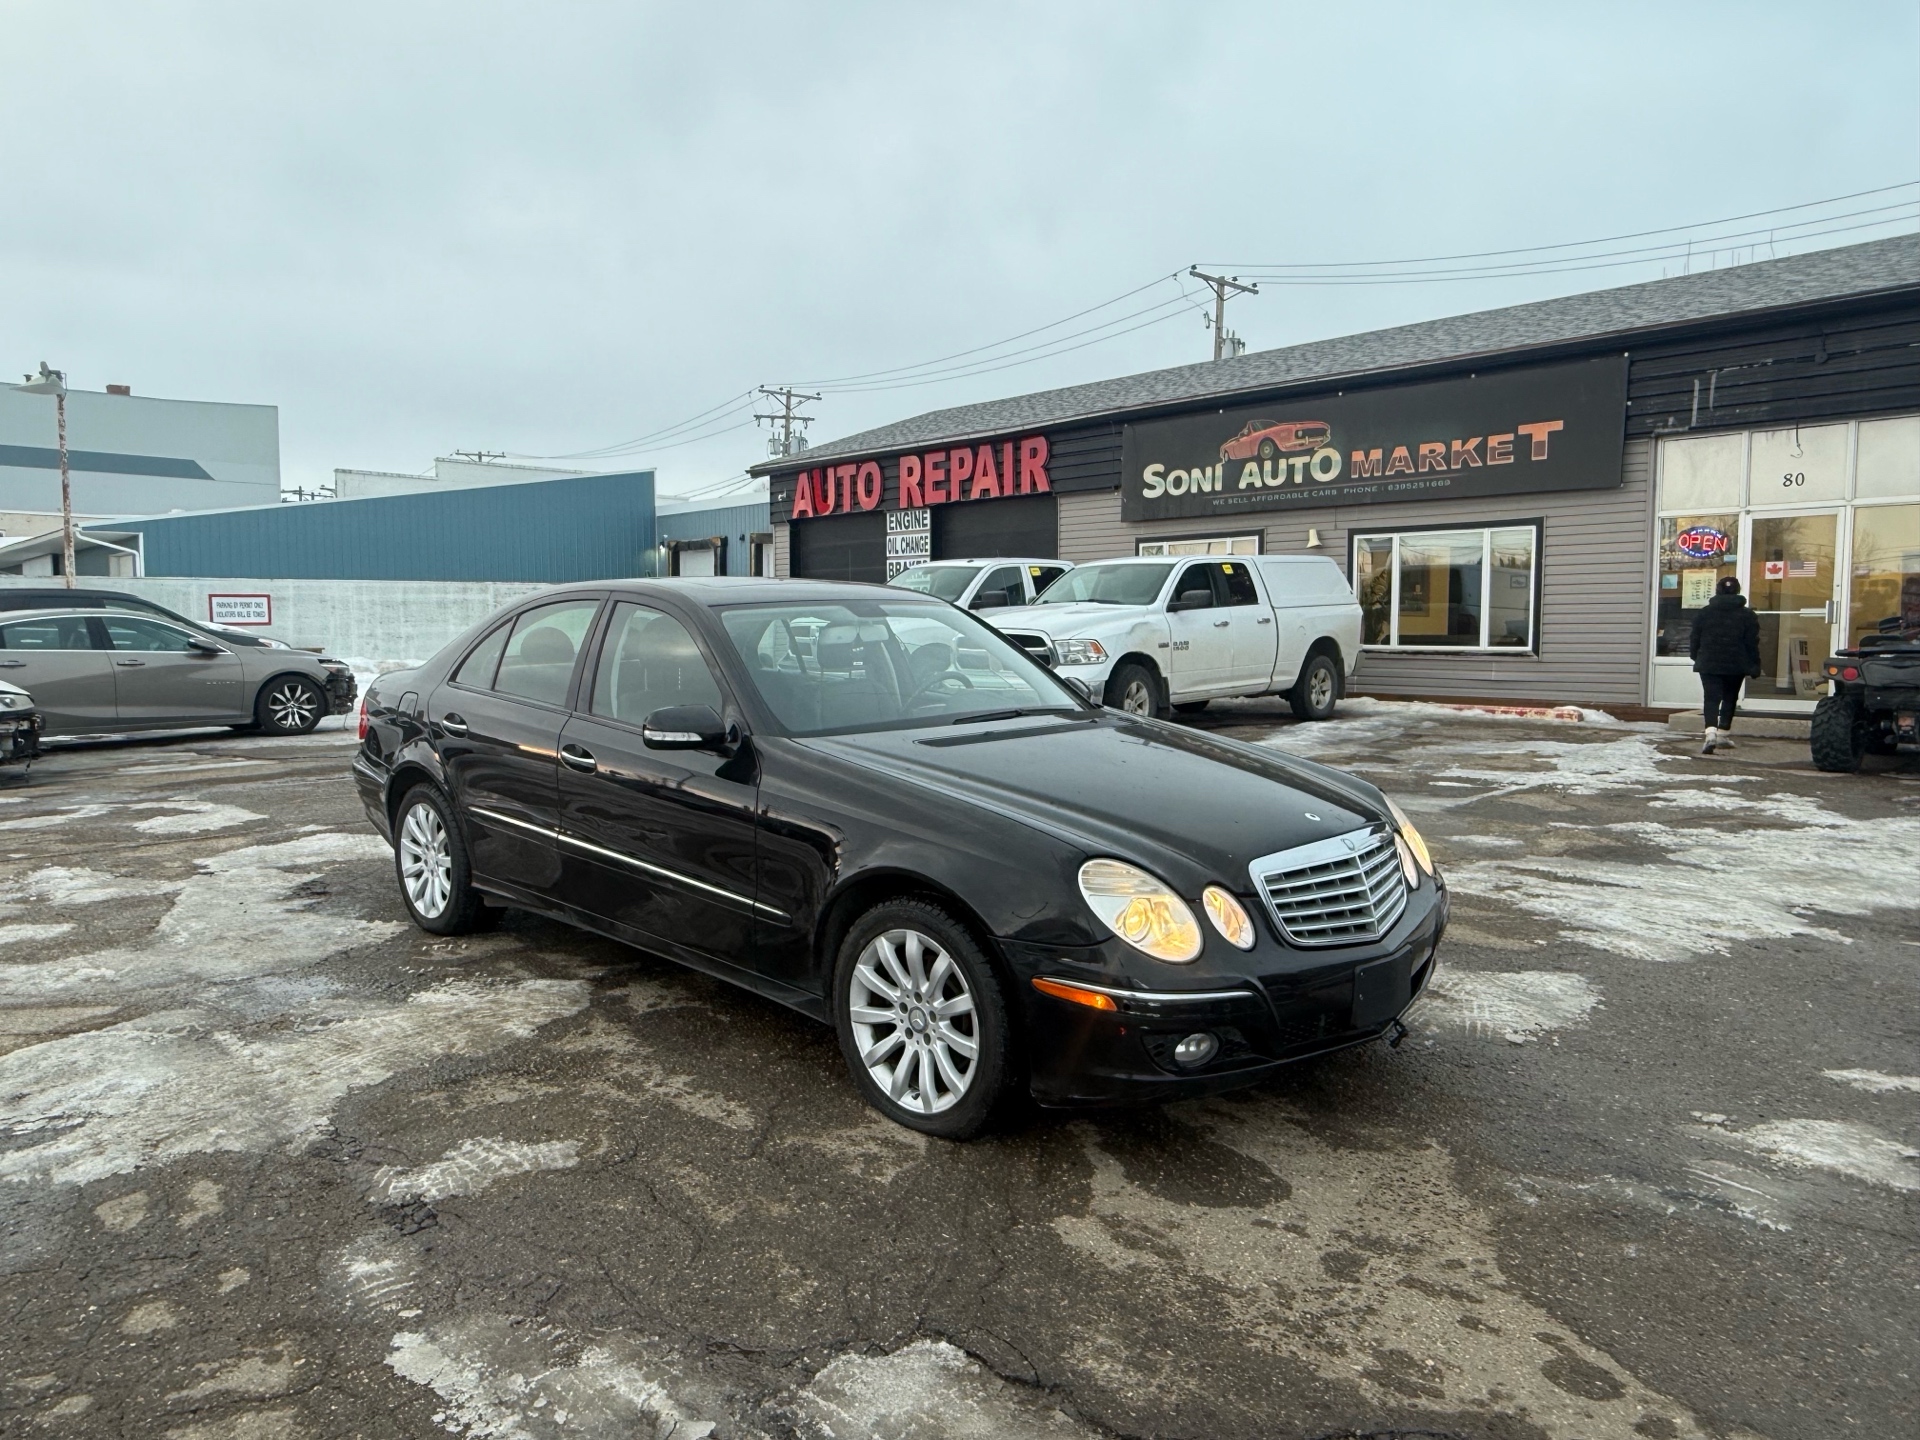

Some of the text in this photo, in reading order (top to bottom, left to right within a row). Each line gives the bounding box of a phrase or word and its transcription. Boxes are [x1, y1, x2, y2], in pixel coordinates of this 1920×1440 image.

[1142, 419, 1564, 499] SONI AUTO MARKET
[792, 434, 1051, 519] AUTO REPAIR
[1782, 472, 1805, 488] 80
[1212, 498, 1225, 506] WE
[1250, 491, 1309, 502] AFFORDABLE
[1311, 488, 1337, 497] CARS
[1343, 485, 1378, 494] PHONE
[888, 510, 929, 531] ENGINE
[887, 535, 929, 555] OIL CHANGE
[1678, 533, 1728, 552] OPEN
[216, 601, 233, 609] PARKING
